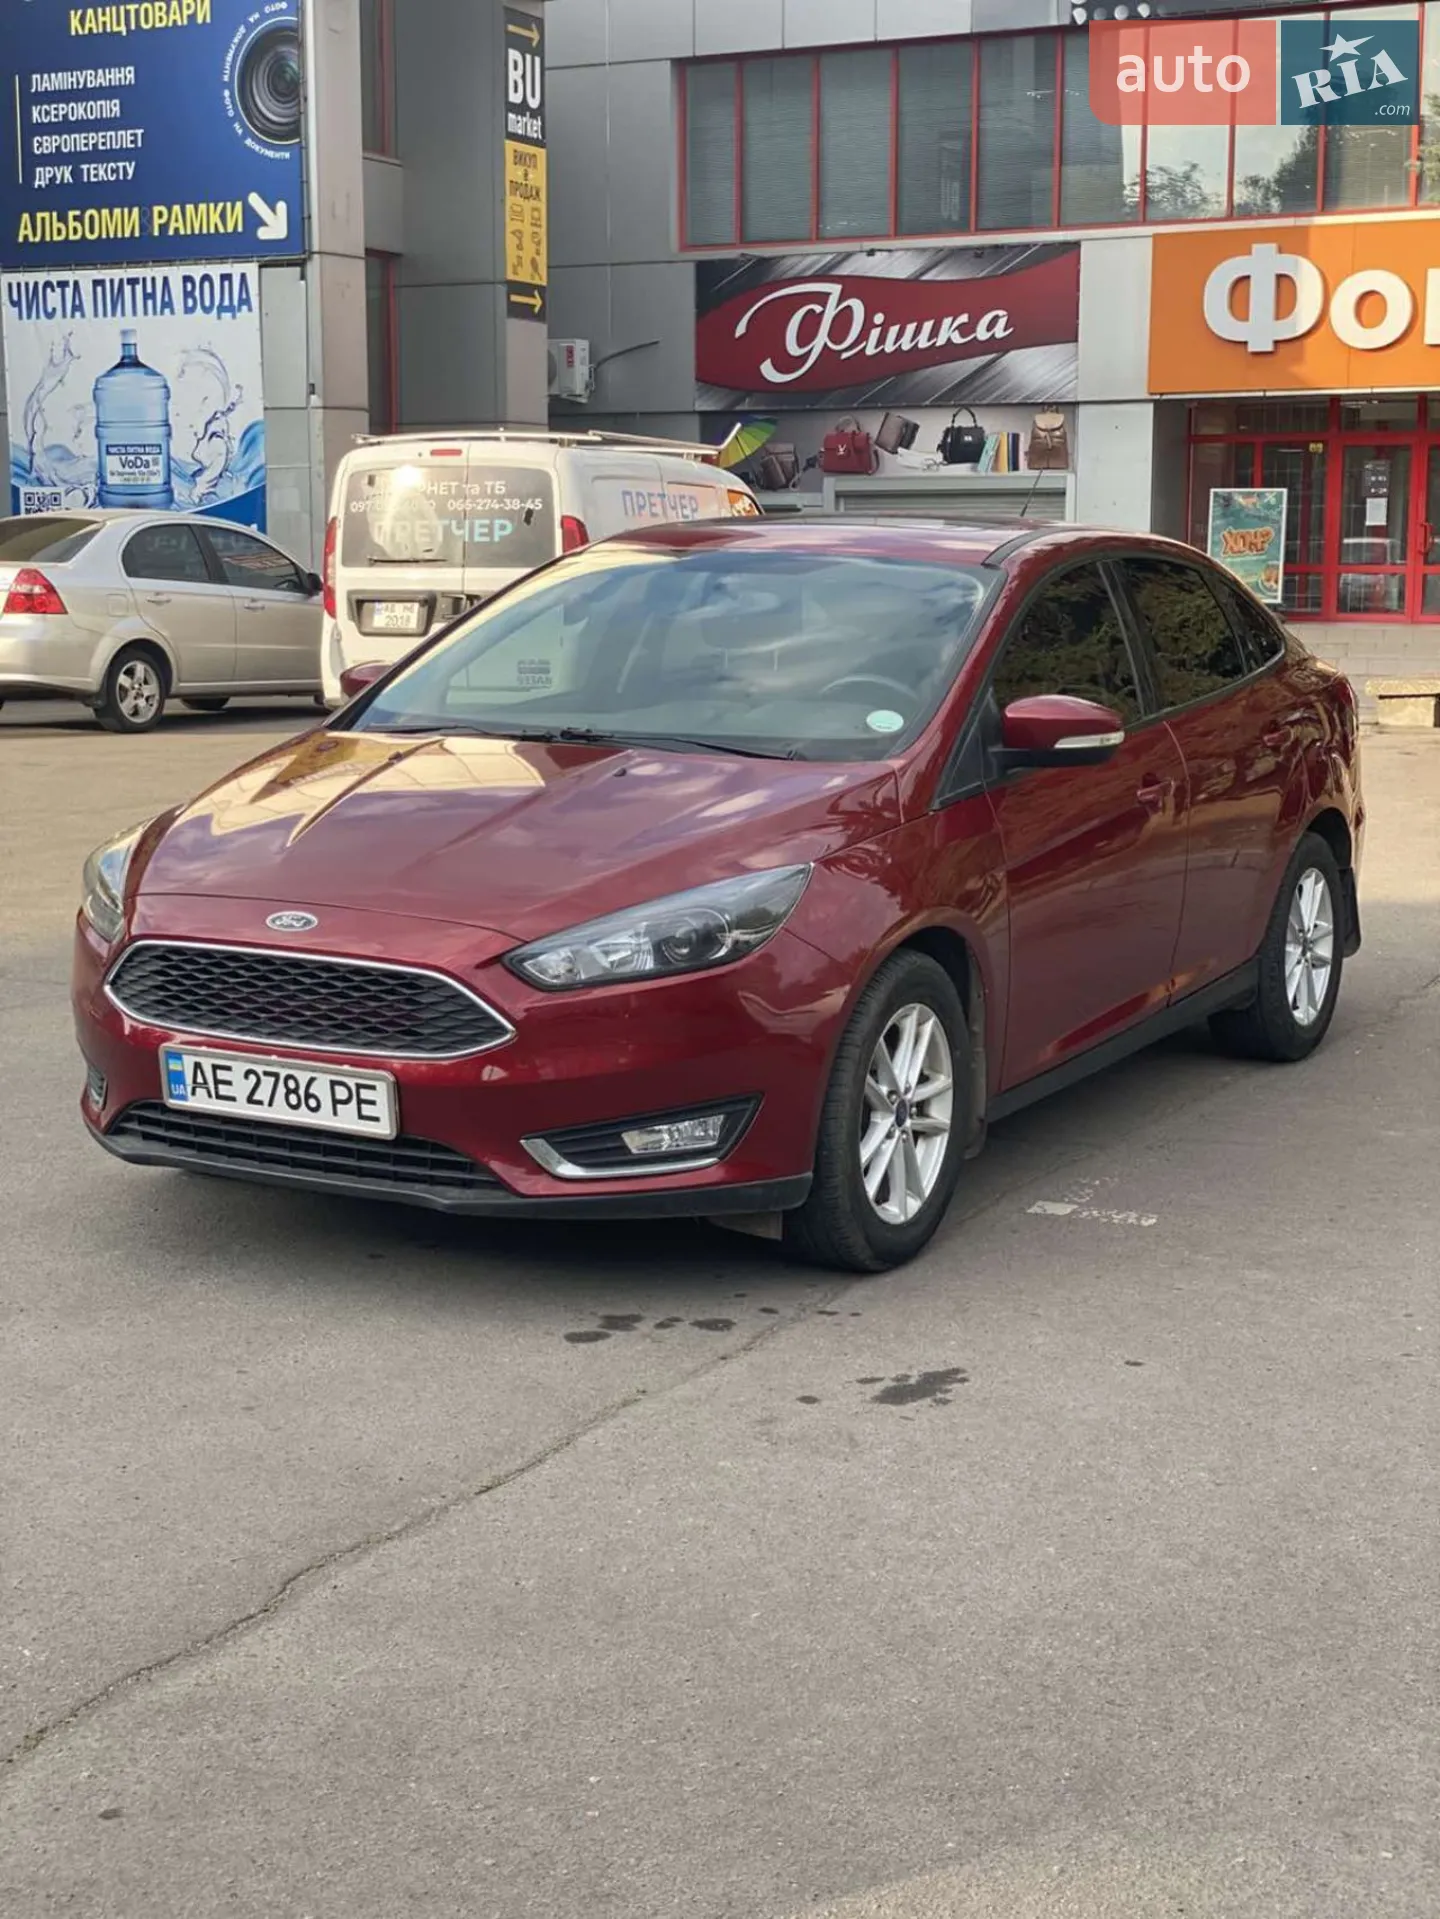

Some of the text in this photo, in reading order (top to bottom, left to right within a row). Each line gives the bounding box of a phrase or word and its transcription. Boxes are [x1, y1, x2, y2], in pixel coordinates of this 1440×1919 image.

[70, 0, 212, 36] КАНЦТОВАРИ
[30, 66, 136, 93] ЛАМІНУВАННЯ
[508, 48, 541, 110] BU
[32, 99, 121, 124] КСЕРОКОПІЯ
[507, 111, 542, 140] market
[33, 128, 144, 155] ЄВРОПЕРЕПЛЕТ
[34, 161, 136, 189] ДРУК ТЕКСТУ
[18, 206, 140, 243] АЛЬБОМИ
[152, 200, 244, 237] РАМКИ
[8, 271, 253, 320] ЧИСТА ПИТНА ВОДА
[1203, 243, 1440, 352] Фо
[735, 282, 1014, 384] Фішка
[119, 456, 150, 469] VoDa
[622, 490, 699, 520] ПРЕТЧЕР
[171, 1083, 186, 1097] UA
[191, 1060, 381, 1123] AE 2786 PE
